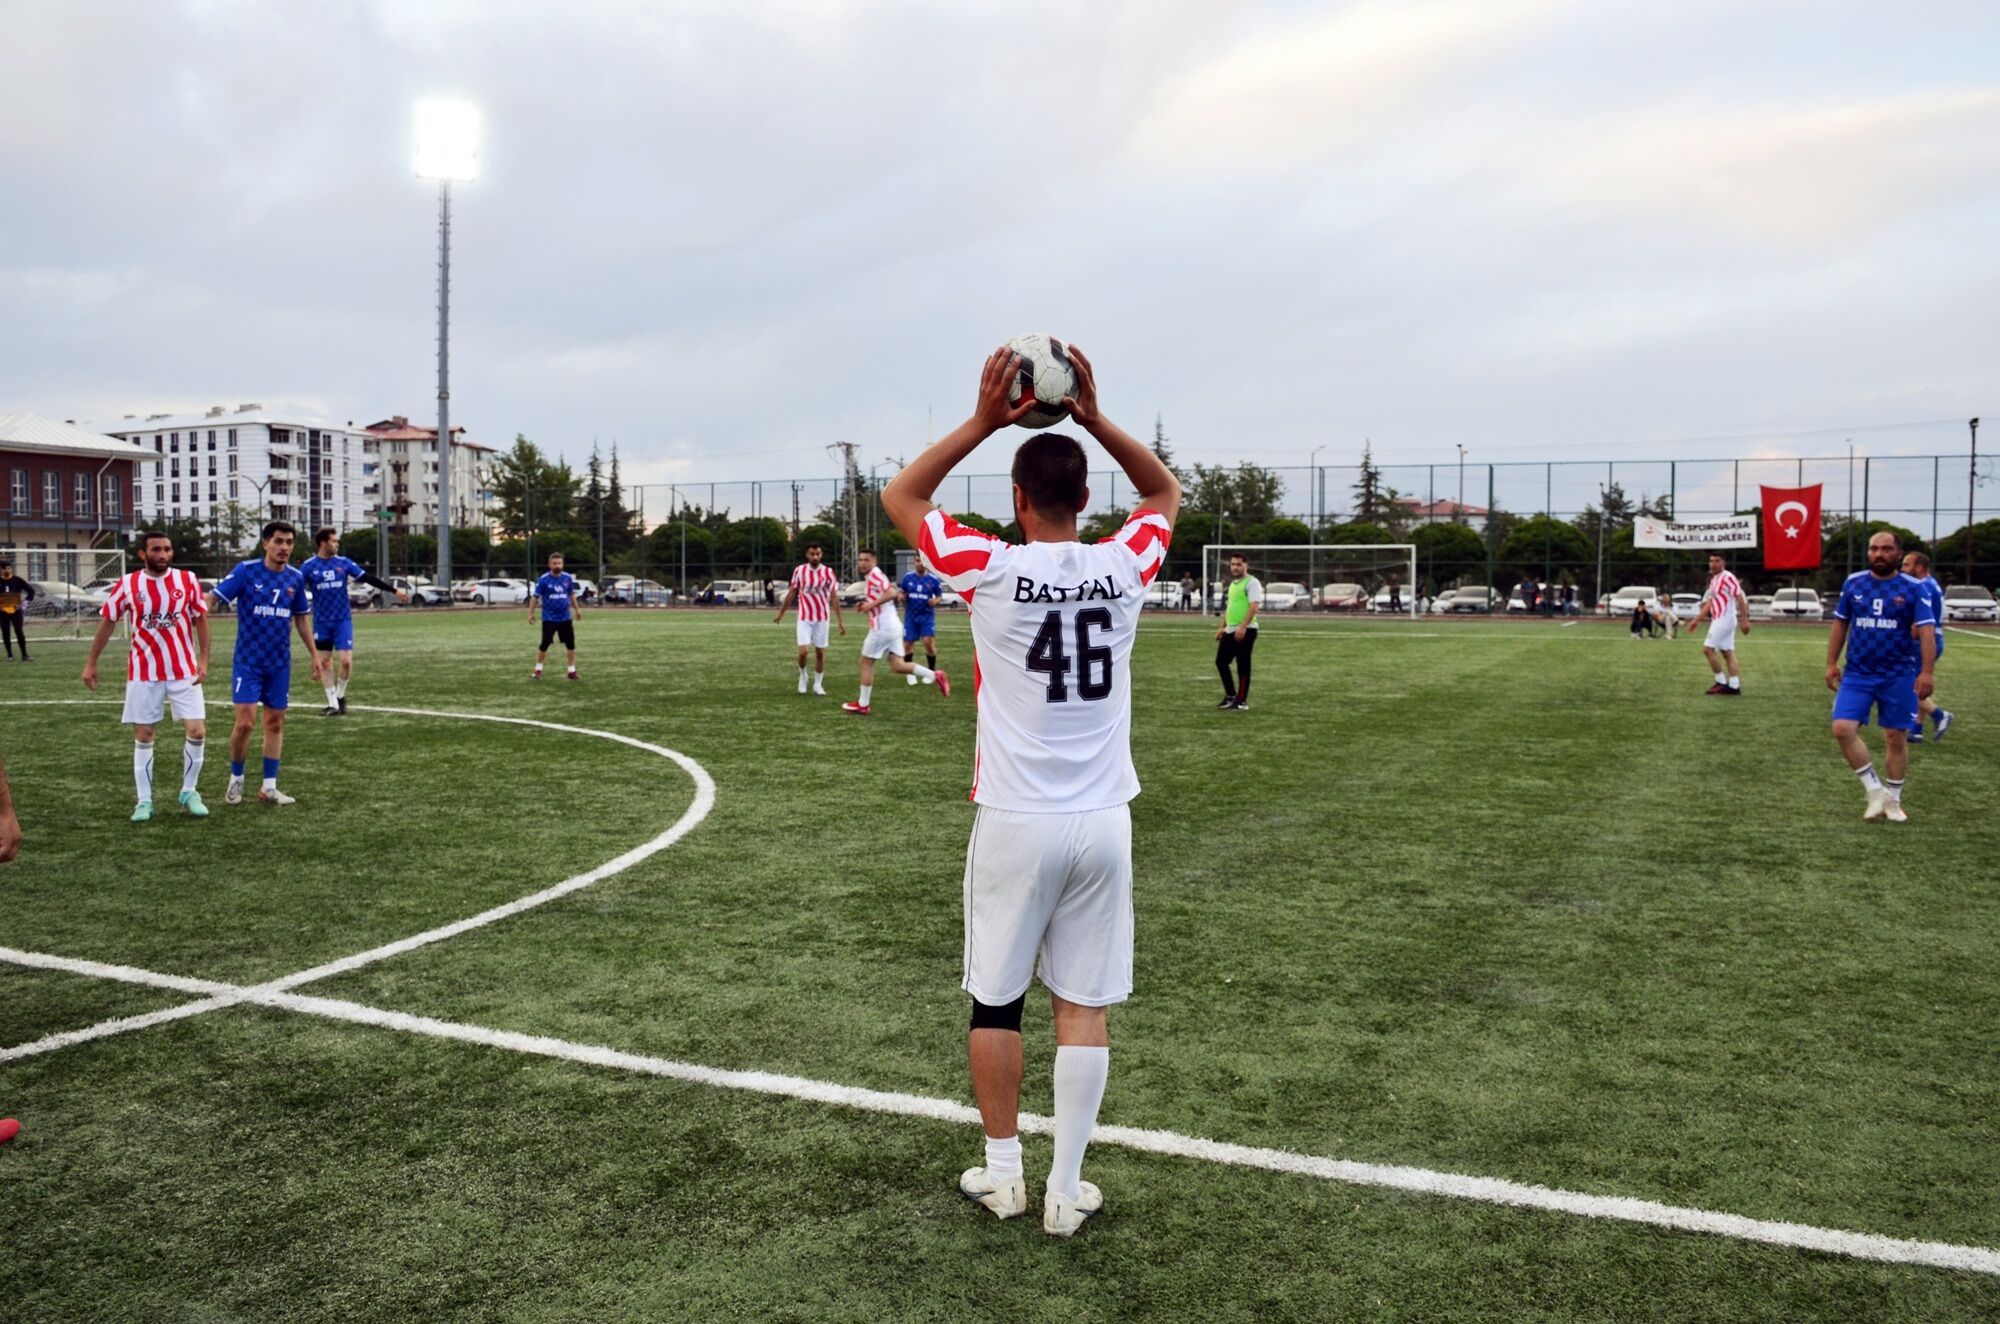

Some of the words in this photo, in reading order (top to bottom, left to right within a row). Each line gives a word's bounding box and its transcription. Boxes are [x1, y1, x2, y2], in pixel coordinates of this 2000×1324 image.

[273, 589, 280, 604] 7
[1013, 574, 1123, 603] BATTAL
[1872, 599, 1883, 615] 9
[1025, 606, 1113, 703] 46
